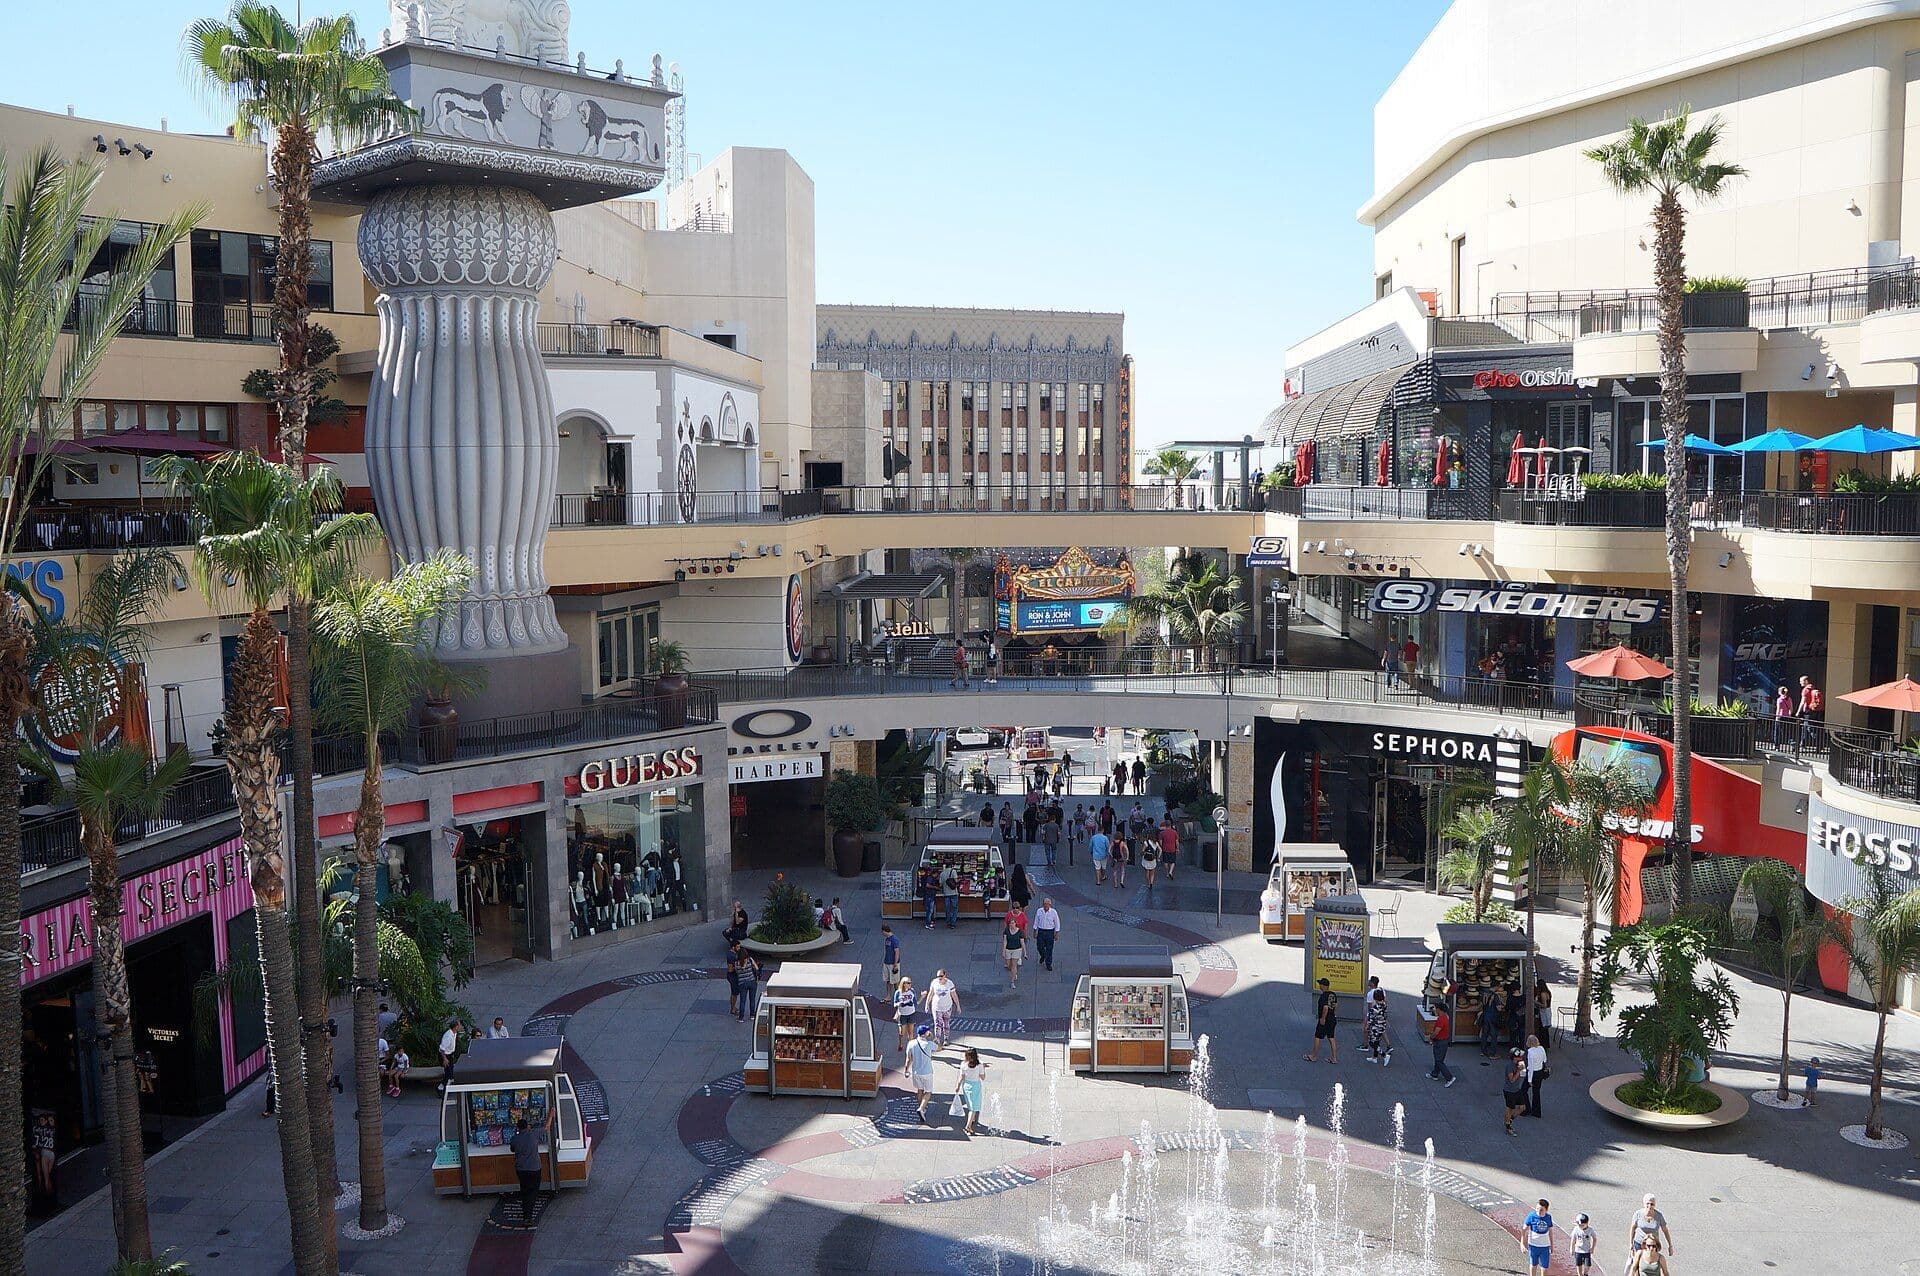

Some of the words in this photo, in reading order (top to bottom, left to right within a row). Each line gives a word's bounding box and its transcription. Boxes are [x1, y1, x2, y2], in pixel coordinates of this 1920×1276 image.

[1473, 369, 1519, 389] Cho
[1520, 367, 1574, 387] Oishi
[1039, 577, 1053, 588] EL
[1056, 576, 1111, 588] CAPITAN
[1437, 588, 1658, 623] SKECHERS
[1028, 612, 1043, 620] RON
[1052, 611, 1071, 619] JOHN
[728, 741, 819, 755] OAKLEY
[1373, 732, 1492, 763] SEPHORA
[580, 746, 698, 792] GUESS
[735, 761, 814, 780] HARPER
[1811, 817, 1920, 874] FOSS
[1318, 949, 1361, 961] MUSEUM
[153, 1034, 173, 1042] SECRET
